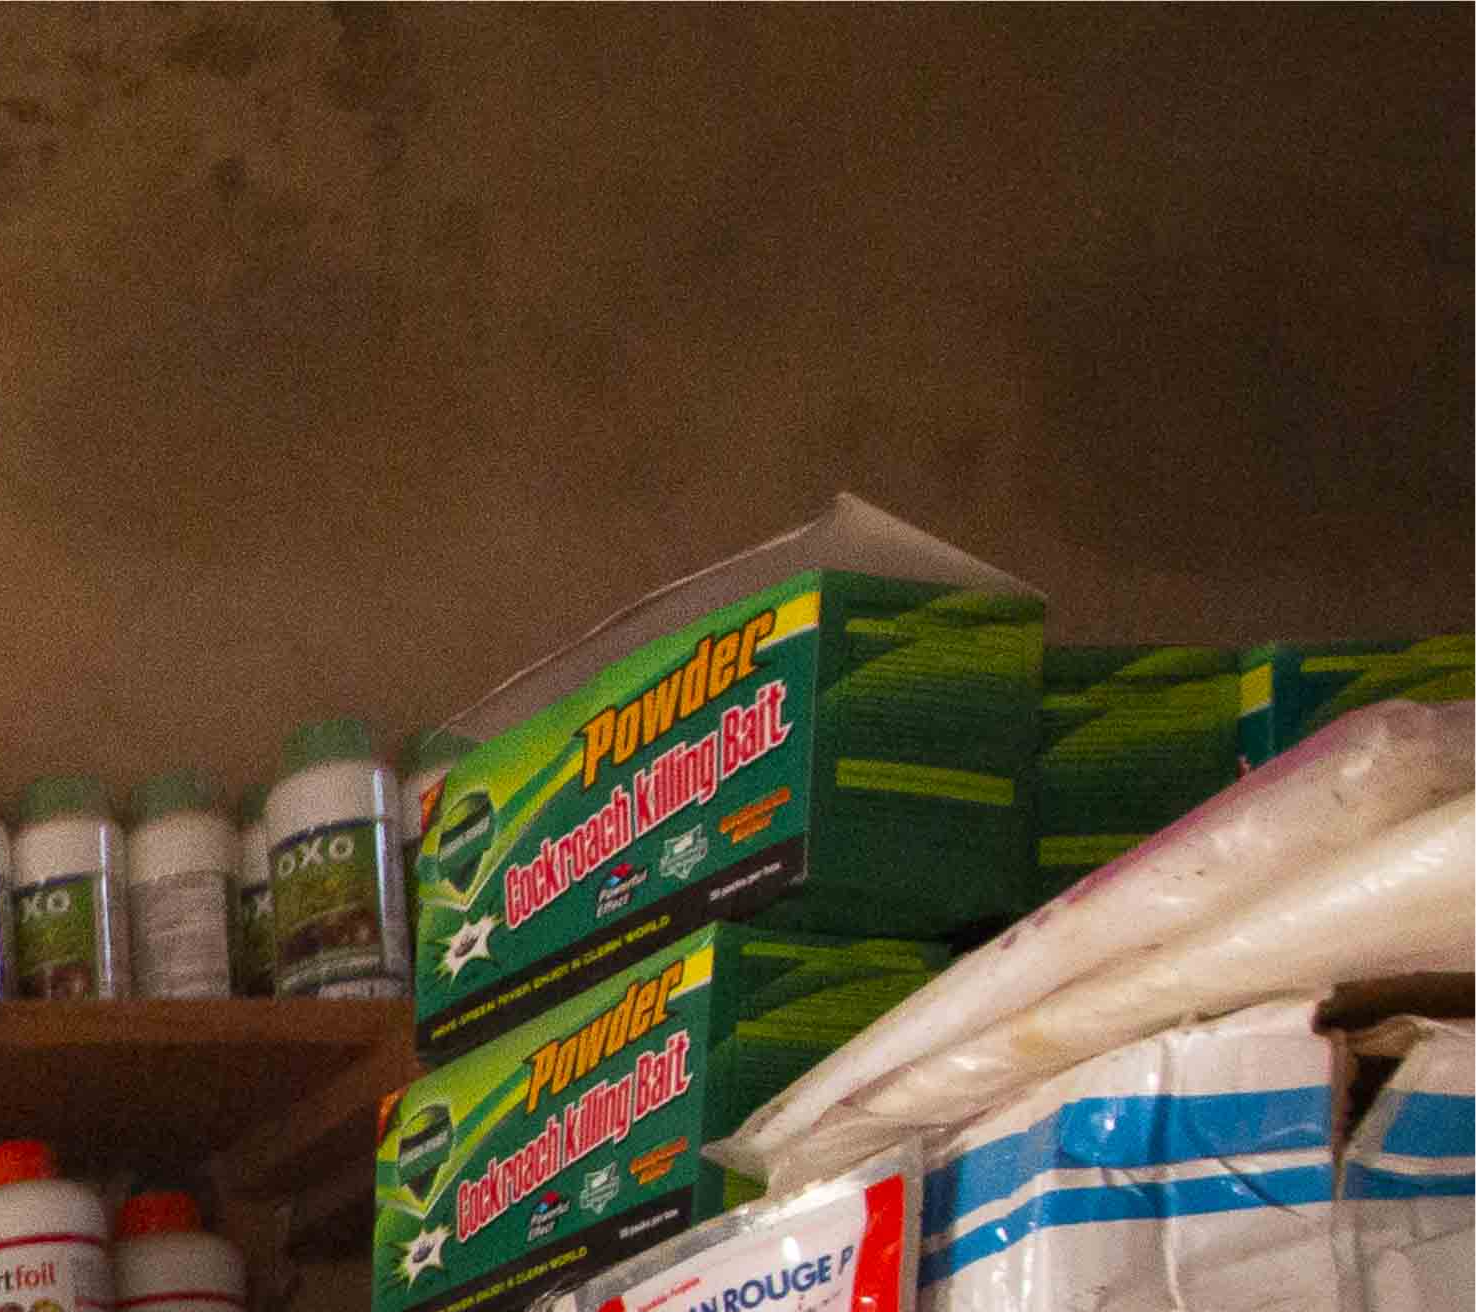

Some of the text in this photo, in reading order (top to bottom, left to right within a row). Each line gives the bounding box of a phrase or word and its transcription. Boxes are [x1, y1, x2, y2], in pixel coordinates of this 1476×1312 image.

[576, 609, 776, 788] Powder
[504, 786, 631, 928] Cockroach
[721, 681, 793, 779] Bait
[526, 961, 683, 1112] Powder
[456, 1113, 561, 1243] Cockroach
[633, 1029, 692, 1122] Bait
